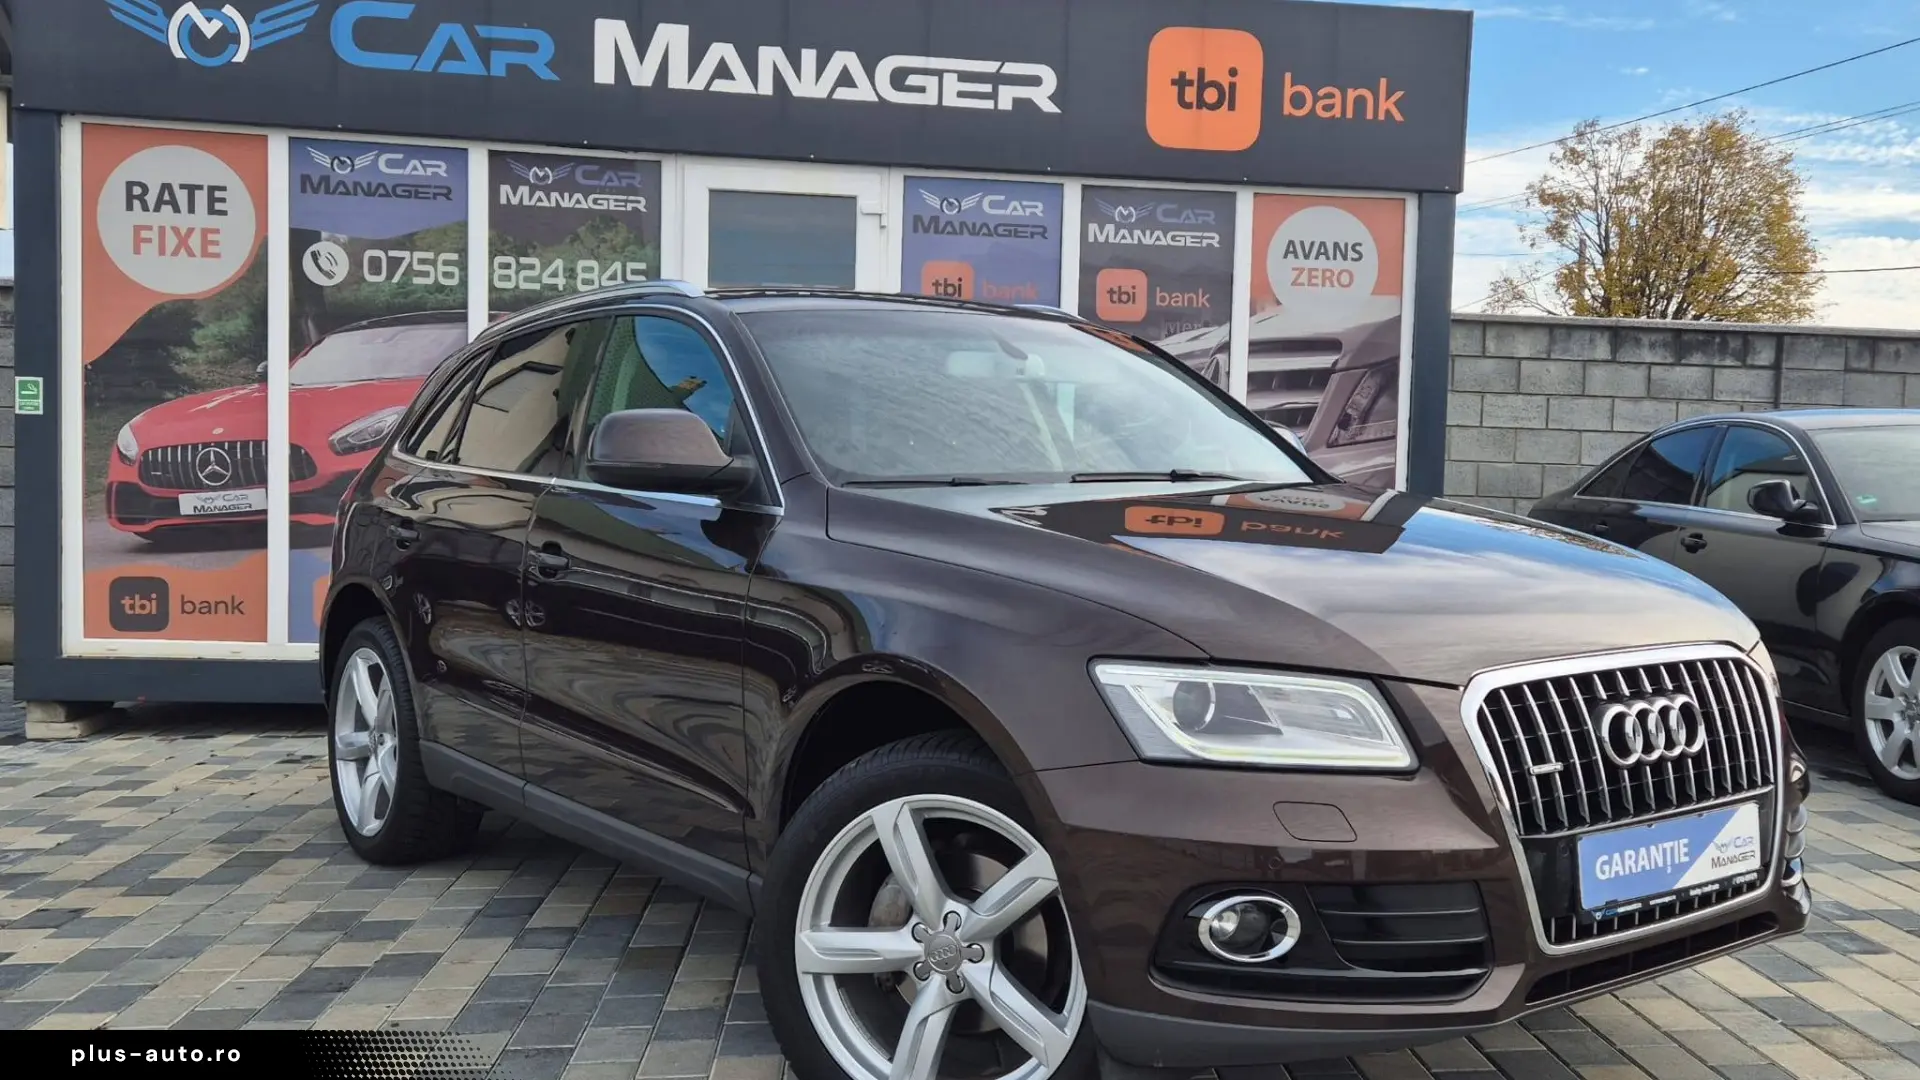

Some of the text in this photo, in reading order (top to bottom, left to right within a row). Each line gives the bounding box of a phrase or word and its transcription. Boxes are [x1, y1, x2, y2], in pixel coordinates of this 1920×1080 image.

[330, 0, 1062, 114] CAR MANAGER
[1171, 66, 1405, 122] tbi bank
[377, 153, 448, 177] CAR
[575, 165, 643, 188] CAR
[124, 180, 229, 217] RATE
[300, 174, 453, 201] MANAGER
[500, 184, 647, 212] MANAGER
[982, 195, 1044, 217] CAR
[1156, 203, 1215, 225] CAR
[912, 214, 1048, 240] MANAGER
[1087, 223, 1221, 248] MANAGER
[131, 223, 222, 259] FIXE
[1283, 239, 1364, 262] AVANS
[363, 249, 460, 286] 0756
[493, 255, 647, 292] 824 845
[1290, 266, 1355, 289] ZERO
[931, 277, 1038, 300] tbi bank
[1106, 285, 1210, 308] tbi bank
[193, 503, 252, 514] MANAGER
[121, 593, 245, 616] tbi bank
[1711, 850, 1756, 870] MANAGER
